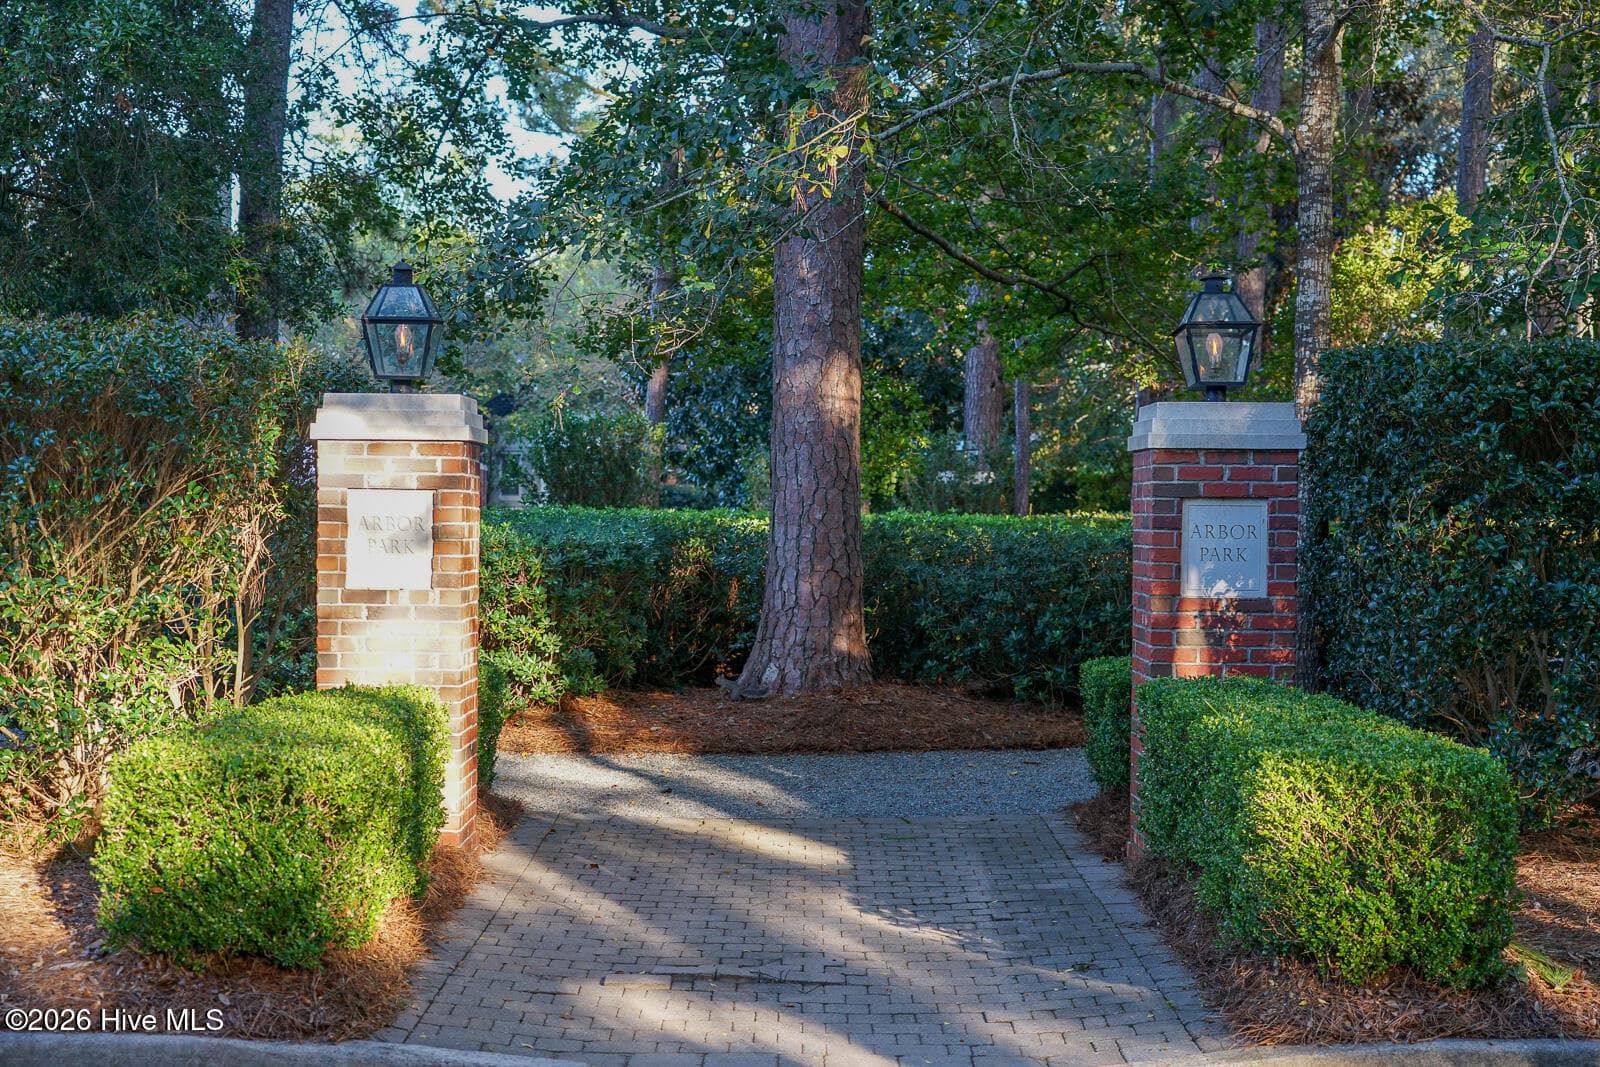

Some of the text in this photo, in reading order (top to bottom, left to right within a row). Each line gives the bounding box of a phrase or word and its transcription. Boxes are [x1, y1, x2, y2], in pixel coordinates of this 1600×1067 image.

[358, 515, 425, 532] ARBOR
[1190, 524, 1258, 540] ARBOR
[367, 538, 415, 554] PARK
[1199, 547, 1248, 562] PARK
